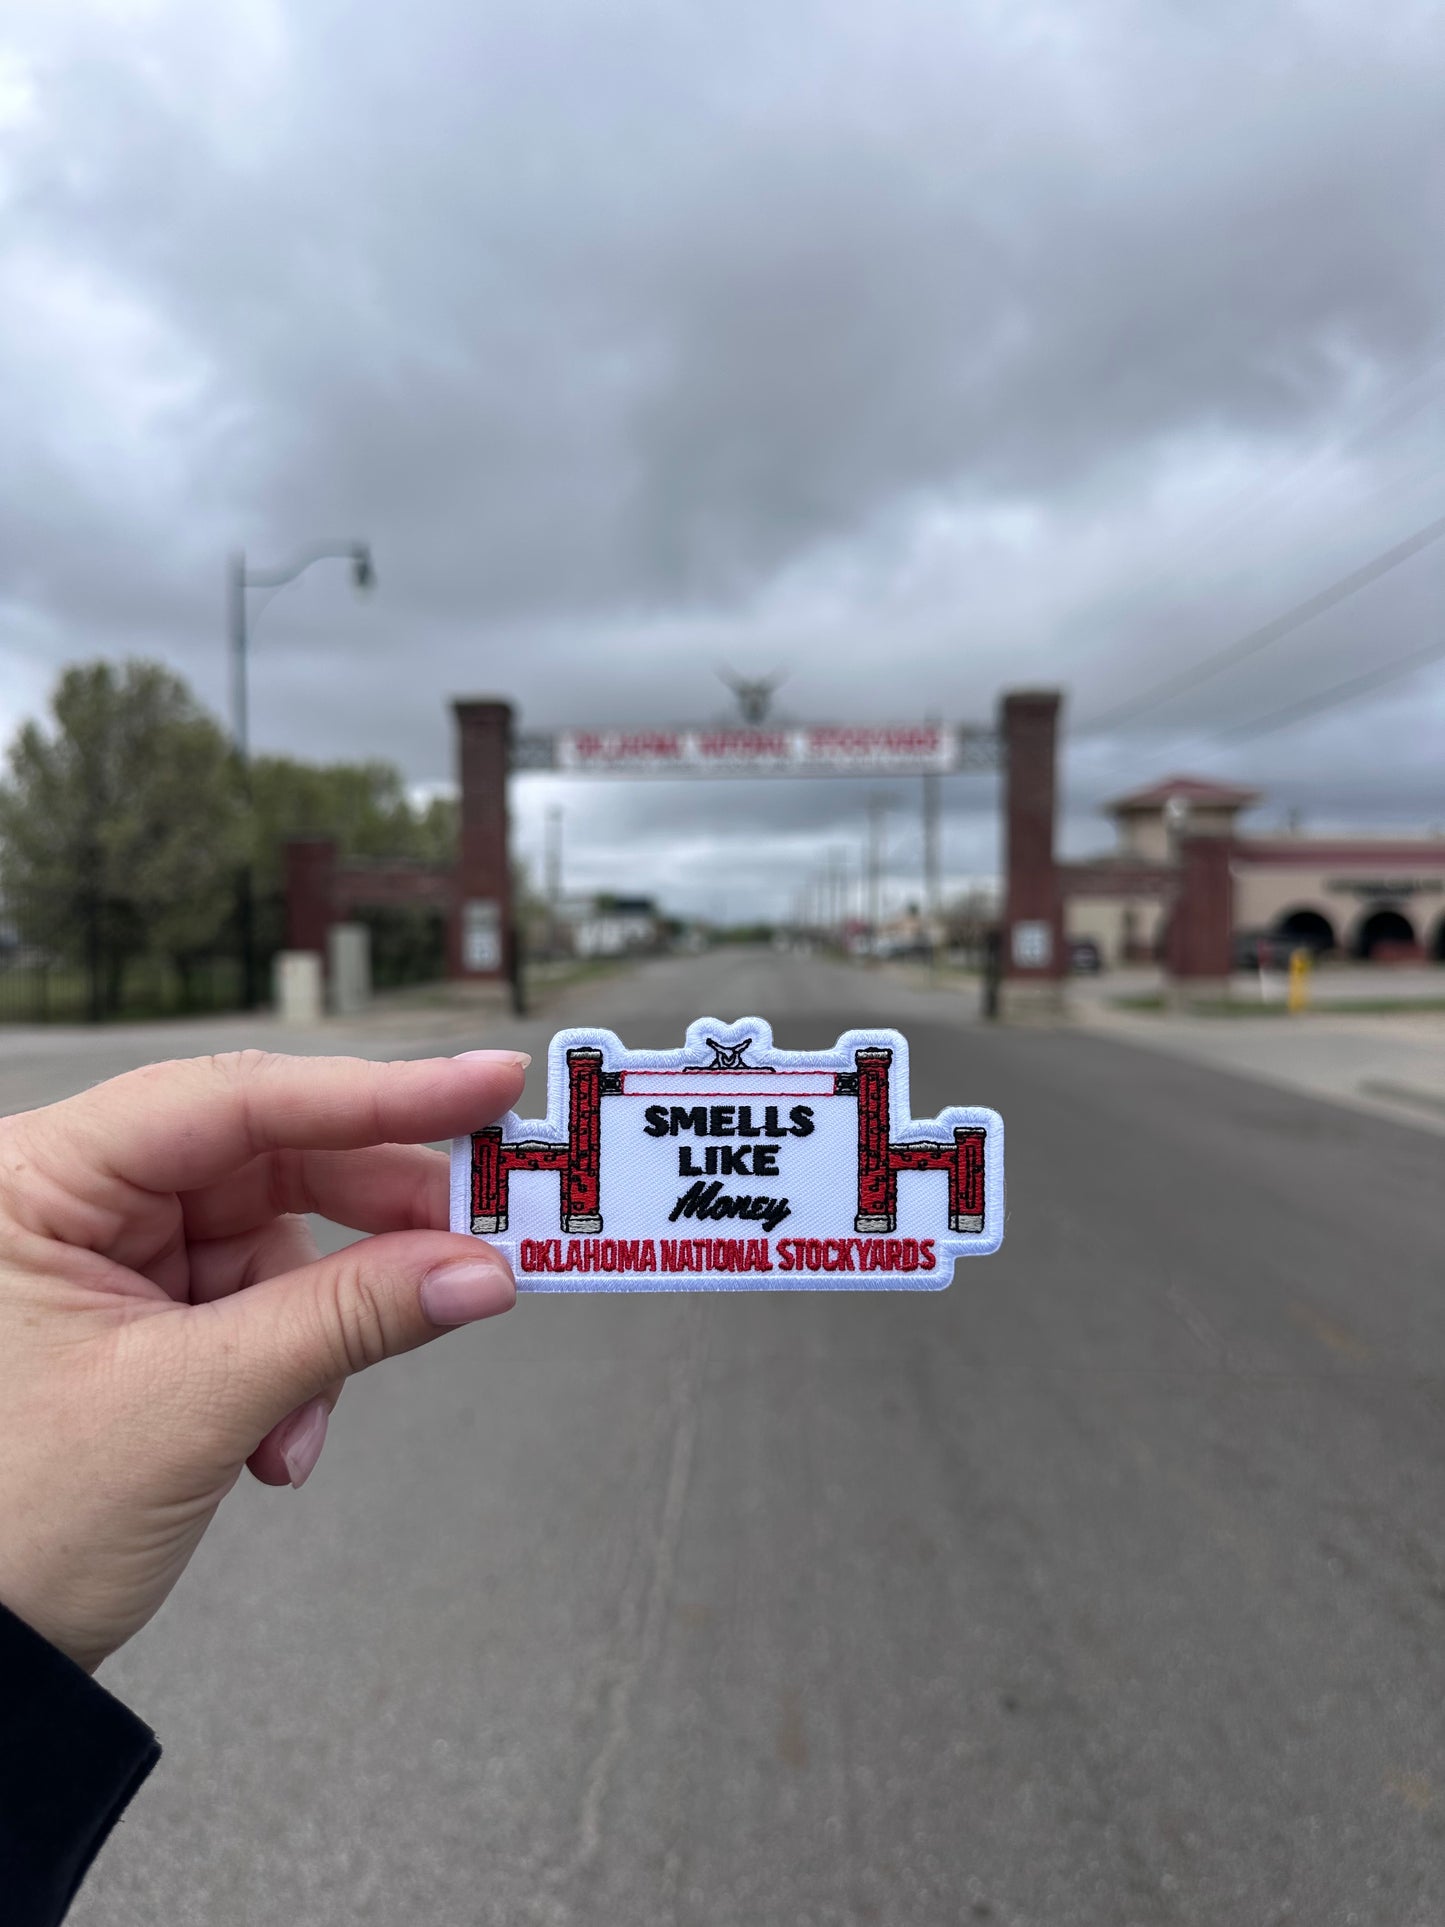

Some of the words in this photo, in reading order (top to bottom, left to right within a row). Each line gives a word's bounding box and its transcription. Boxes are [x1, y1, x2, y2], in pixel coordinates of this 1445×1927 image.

[644, 1105, 815, 1137] SMELLS
[678, 1145, 780, 1176] LIKE
[668, 1181, 790, 1232] Money
[520, 1239, 655, 1273] OKLAHOMA
[660, 1239, 773, 1272] NATIONAL
[778, 1238, 936, 1271] STOCKYARDS
